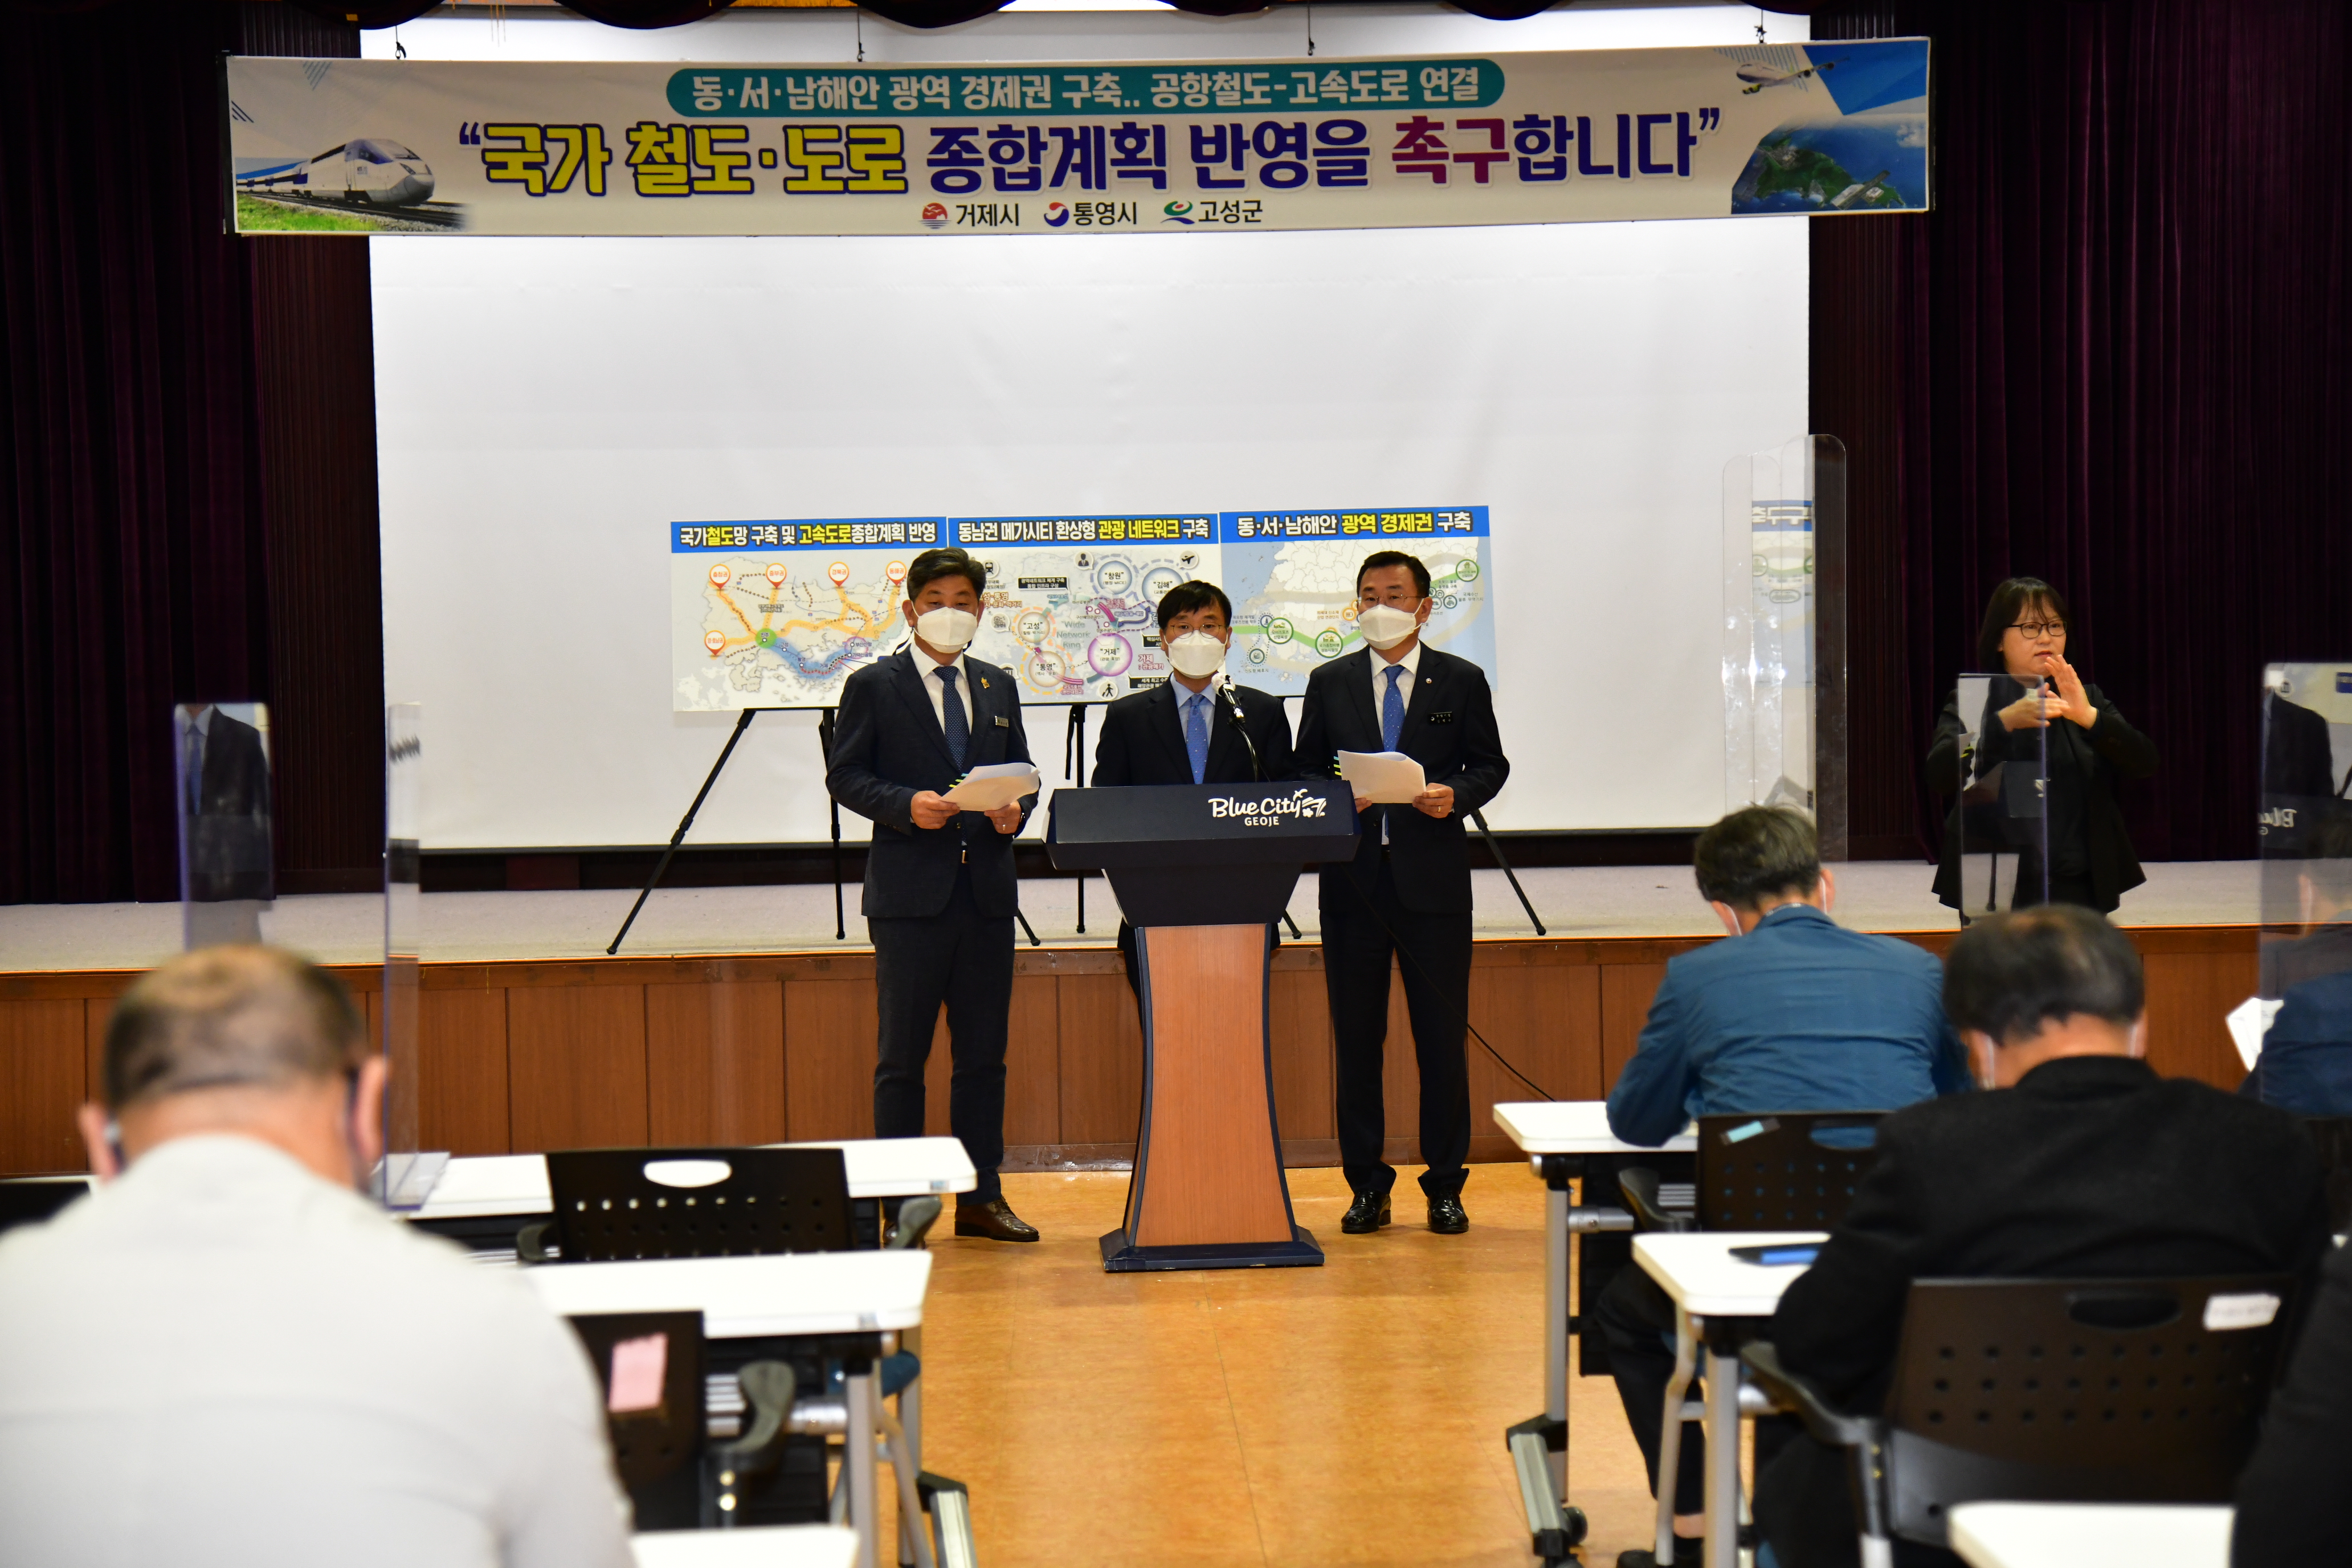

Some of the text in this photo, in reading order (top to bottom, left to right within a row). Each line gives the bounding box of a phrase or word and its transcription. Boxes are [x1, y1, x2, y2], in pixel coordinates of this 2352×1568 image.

[692, 66, 1479, 111] 동·서·남해안 광역 경제권 구축.. 공항철도-고속도로 연결
[459, 107, 1720, 197] “국가 철도·도로 종합계획 반영을 촉구합니다”
[956, 202, 1019, 227] 거제시
[1073, 201, 1137, 226] 통영시
[1198, 199, 1263, 223] 고성군
[680, 521, 936, 547] 국가철도망 구축 및 고속도로종합계획 반영
[958, 518, 1209, 542] 동남권 메가시티 환상형 관광 네트워크 구축
[1237, 511, 1471, 537] 동·서·남해안 광역 경제권 구축
[1138, 654, 1153, 663] 거제
[1208, 797, 1301, 818] Blue City
[1244, 816, 1280, 827] GEOJE
